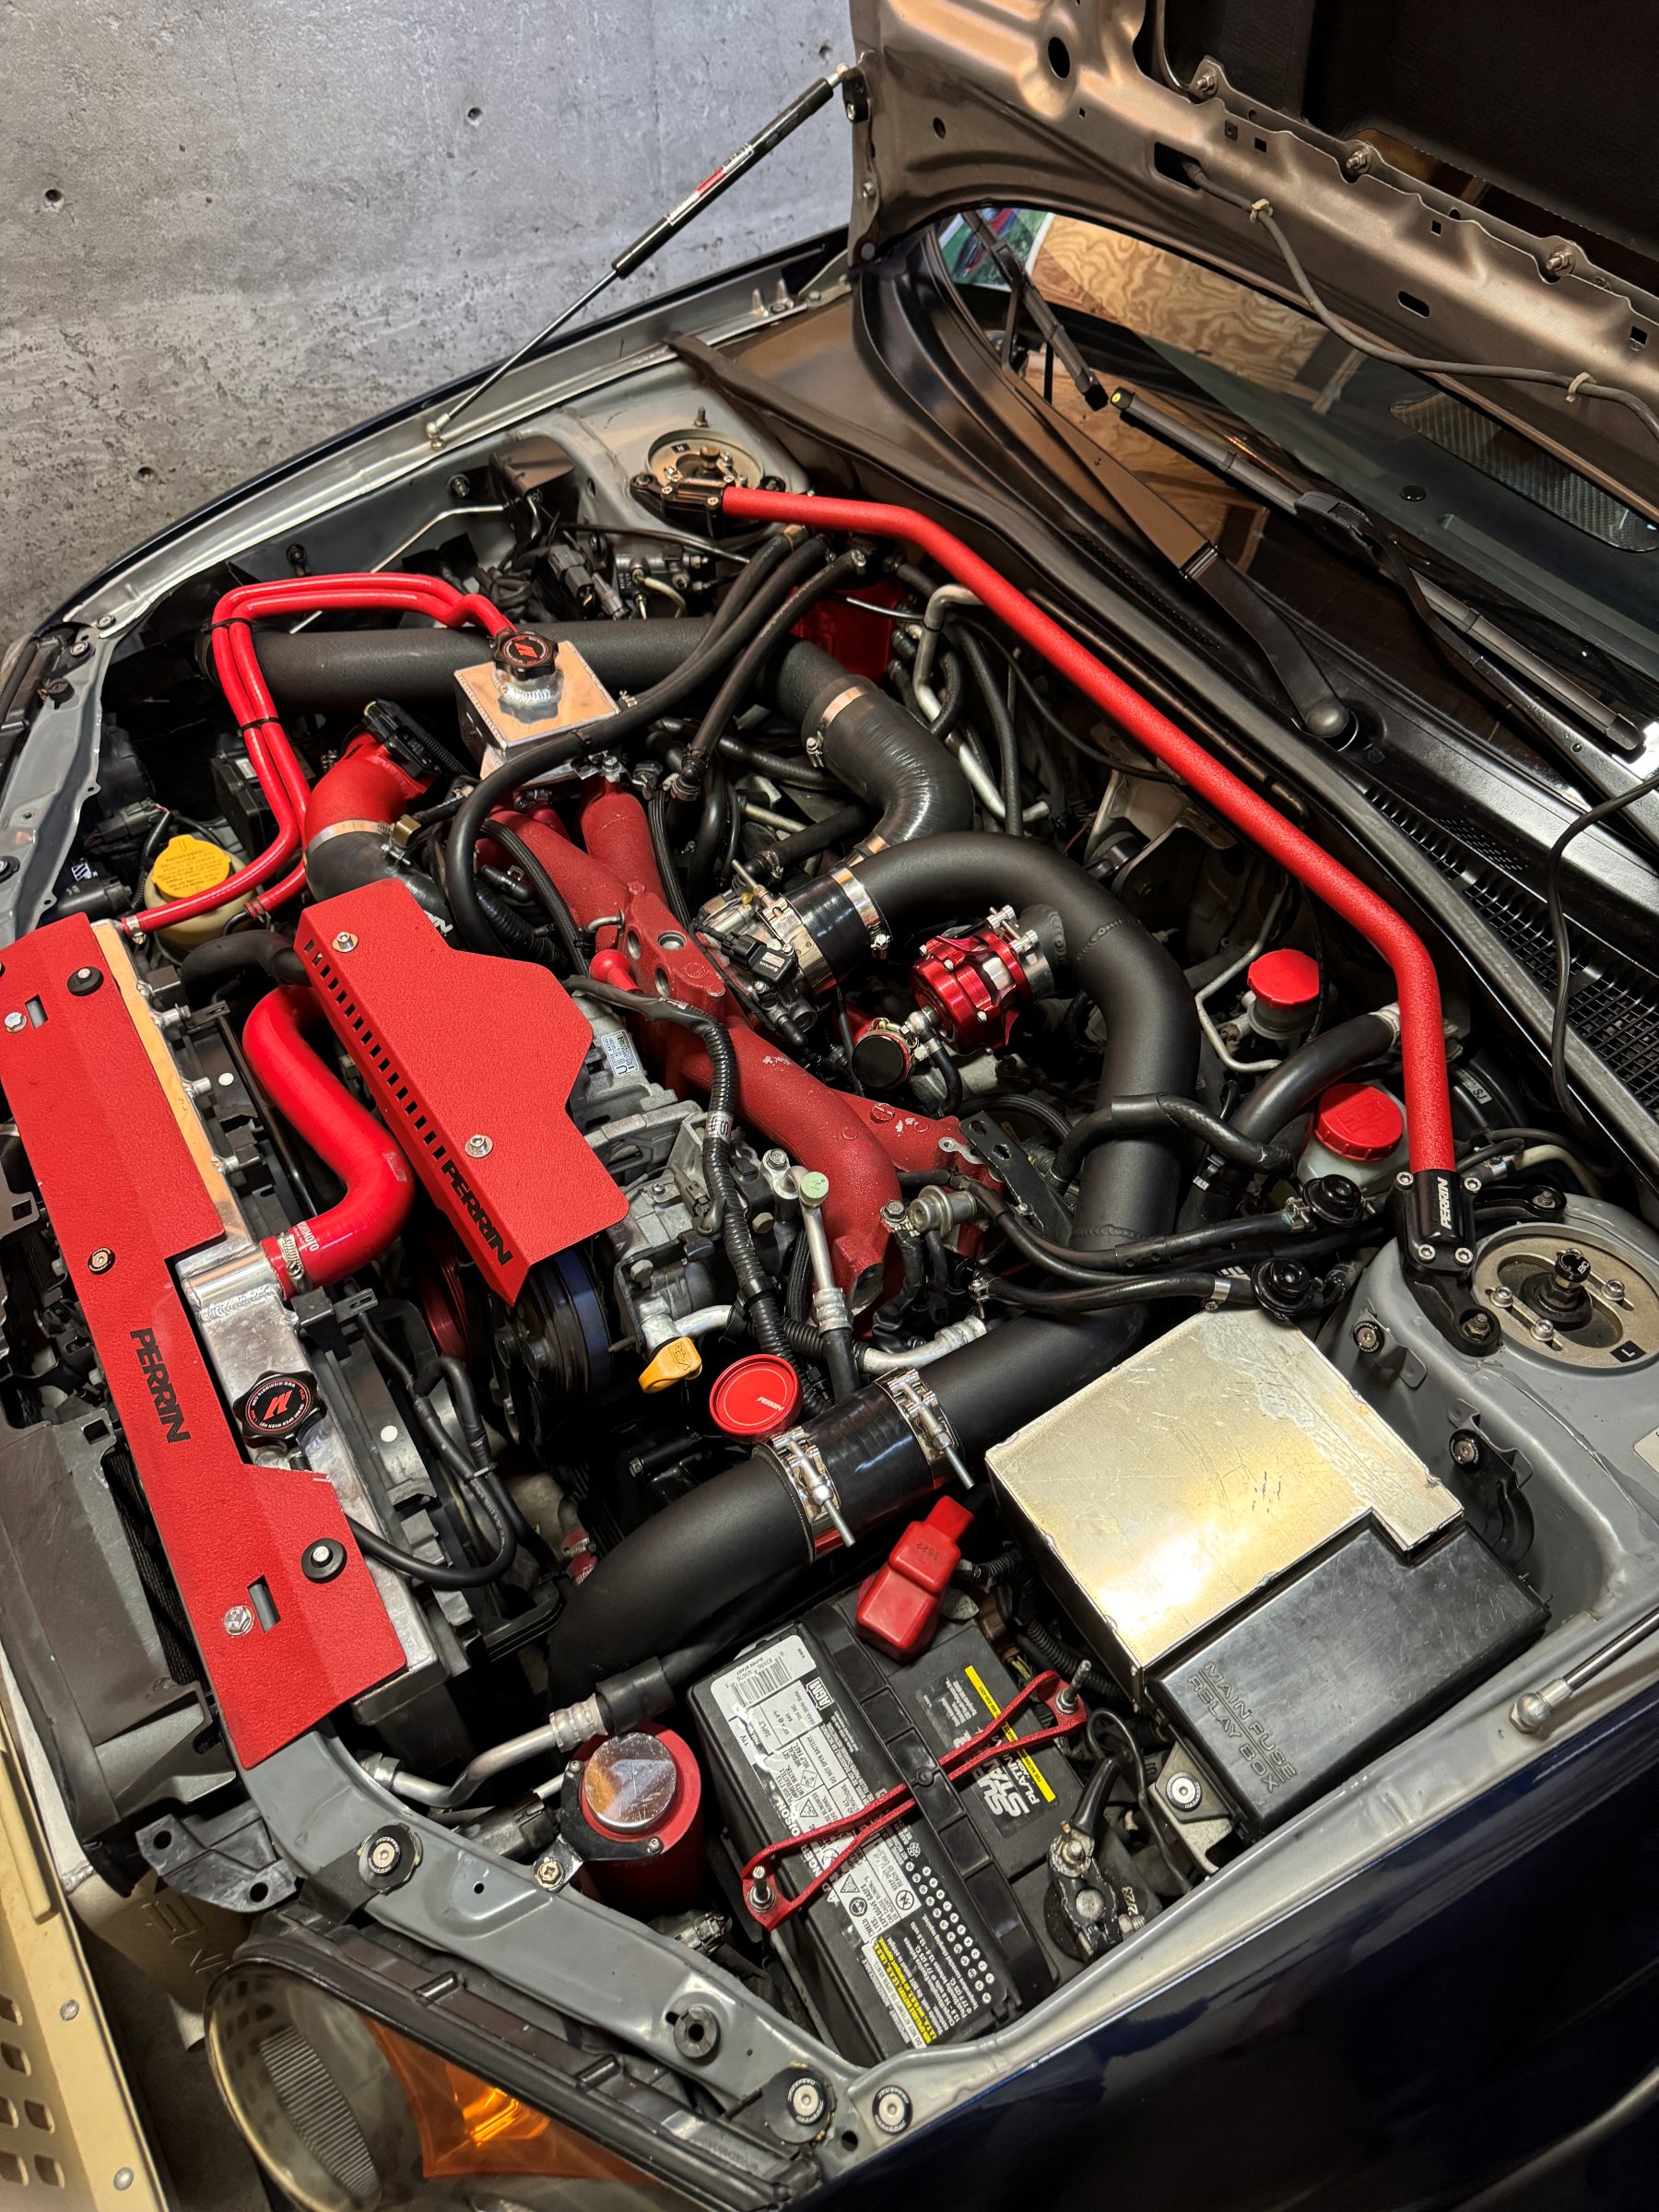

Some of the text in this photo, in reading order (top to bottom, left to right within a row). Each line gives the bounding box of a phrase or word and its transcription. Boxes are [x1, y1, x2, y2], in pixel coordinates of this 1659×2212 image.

[442, 1159, 513, 1266] PERRIN
[1437, 1177, 1452, 1230] PERRIN
[130, 1327, 191, 1443] PERRIN
[808, 1678, 831, 1707] AGM
[1204, 1661, 1297, 1781] MAIN FUSE
[739, 1734, 750, 1746] 12V
[1188, 1674, 1278, 1793] RELAY BOX
[781, 1749, 790, 1759] GET
[786, 1745, 802, 1767] MEDICAL
[799, 1755, 810, 1768] HELP
[817, 1754, 828, 1767] OPEN
[823, 1766, 833, 1777] NOT
[951, 1730, 1010, 1818] SUPR
[990, 1731, 1041, 1807] PLATINM
[774, 1774, 794, 1803] FLUSH EYES
[778, 1768, 799, 1799] IMMEDIATELY
[794, 1782, 805, 1795] WITH
[840, 1783, 860, 1812] STRUCTIONS.
[841, 1798, 850, 1807] ALL
[774, 1798, 802, 1837] OISON
[798, 1842, 832, 1893] DNGER
[881, 1867, 891, 1878] OUT
[888, 1877, 898, 1890] KEEP
[890, 1871, 903, 1888] REACH
[869, 1899, 888, 1927] EXPLOSIVE
[877, 1899, 888, 1913] CAUSE
[886, 1913, 894, 1923] CAN
[902, 1936, 918, 1959] between
[933, 1933, 949, 1957] charging
[932, 1960, 947, 1983] between
[945, 1955, 961, 1979] corrected
[881, 1977, 893, 1993] OPEN
[909, 1977, 919, 1990] NOT
[958, 1976, 979, 2009] Temperature
[889, 1992, 898, 2000] TO
[895, 2001, 912, 2025] ATTEMPT
[907, 2024, 918, 2036] NOT
[913, 2036, 923, 2045] DO
